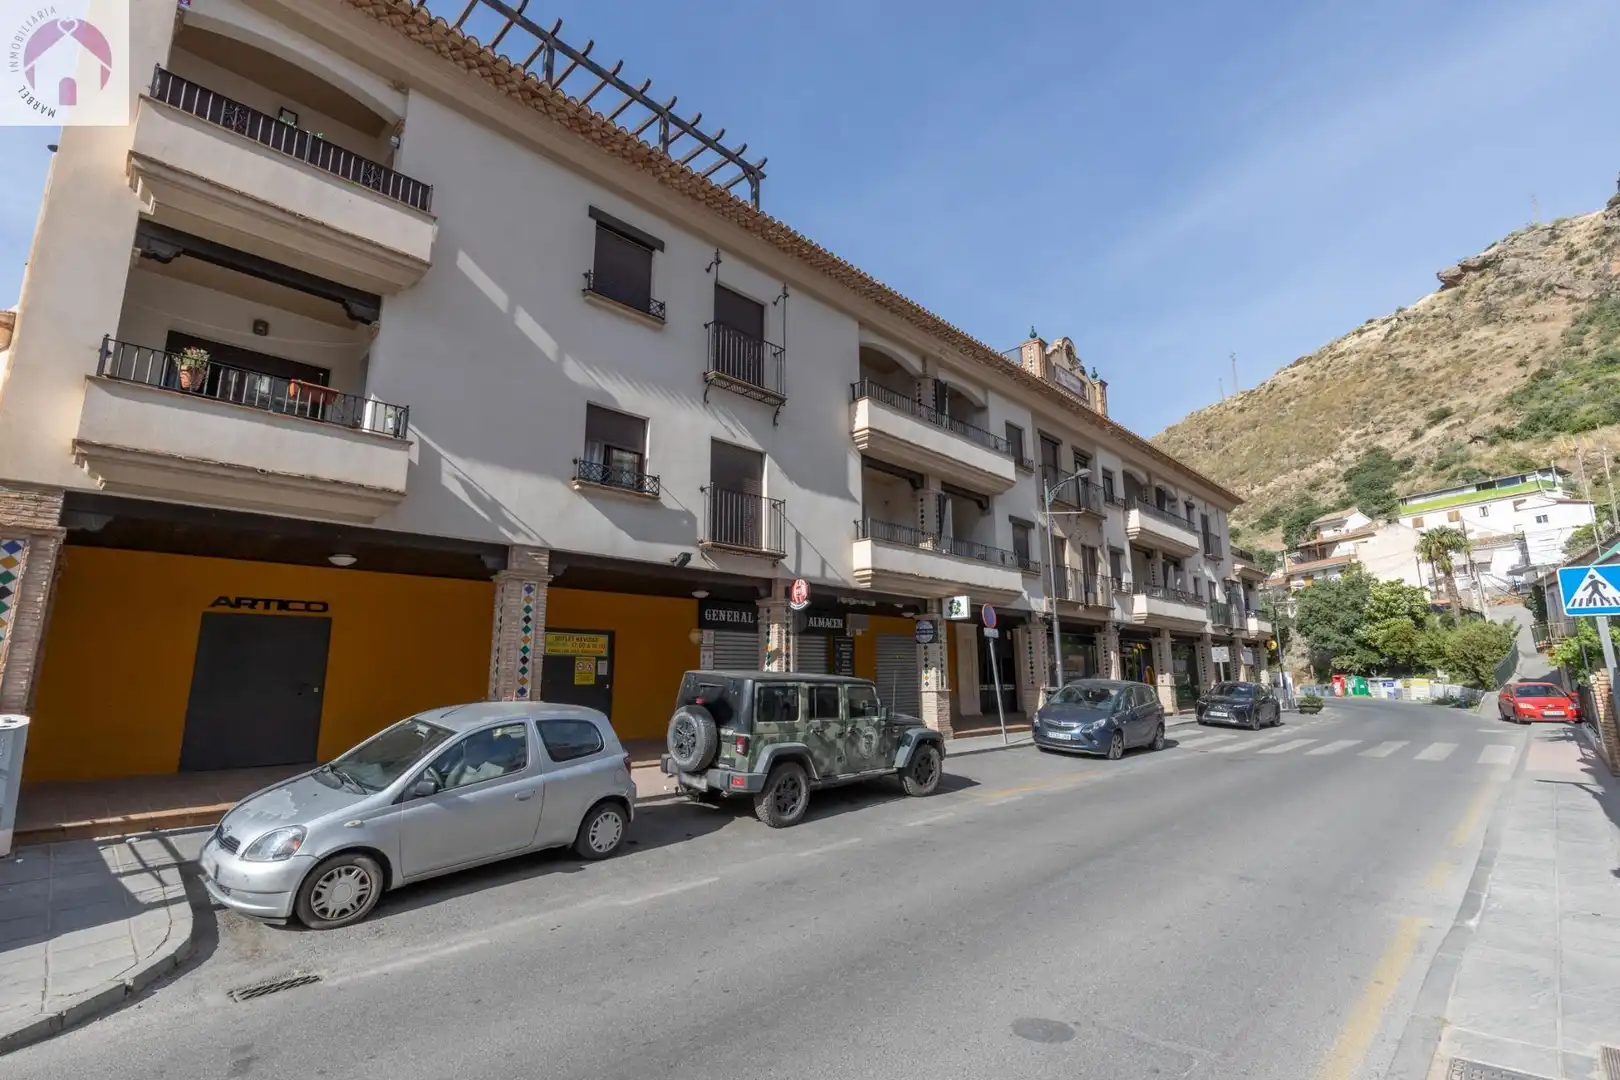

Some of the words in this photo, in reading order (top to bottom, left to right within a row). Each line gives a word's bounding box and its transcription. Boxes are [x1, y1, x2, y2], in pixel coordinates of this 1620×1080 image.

[209, 596, 328, 612] ARTICO
[704, 608, 754, 623] GENERAL
[808, 616, 844, 629] ALMACEN
